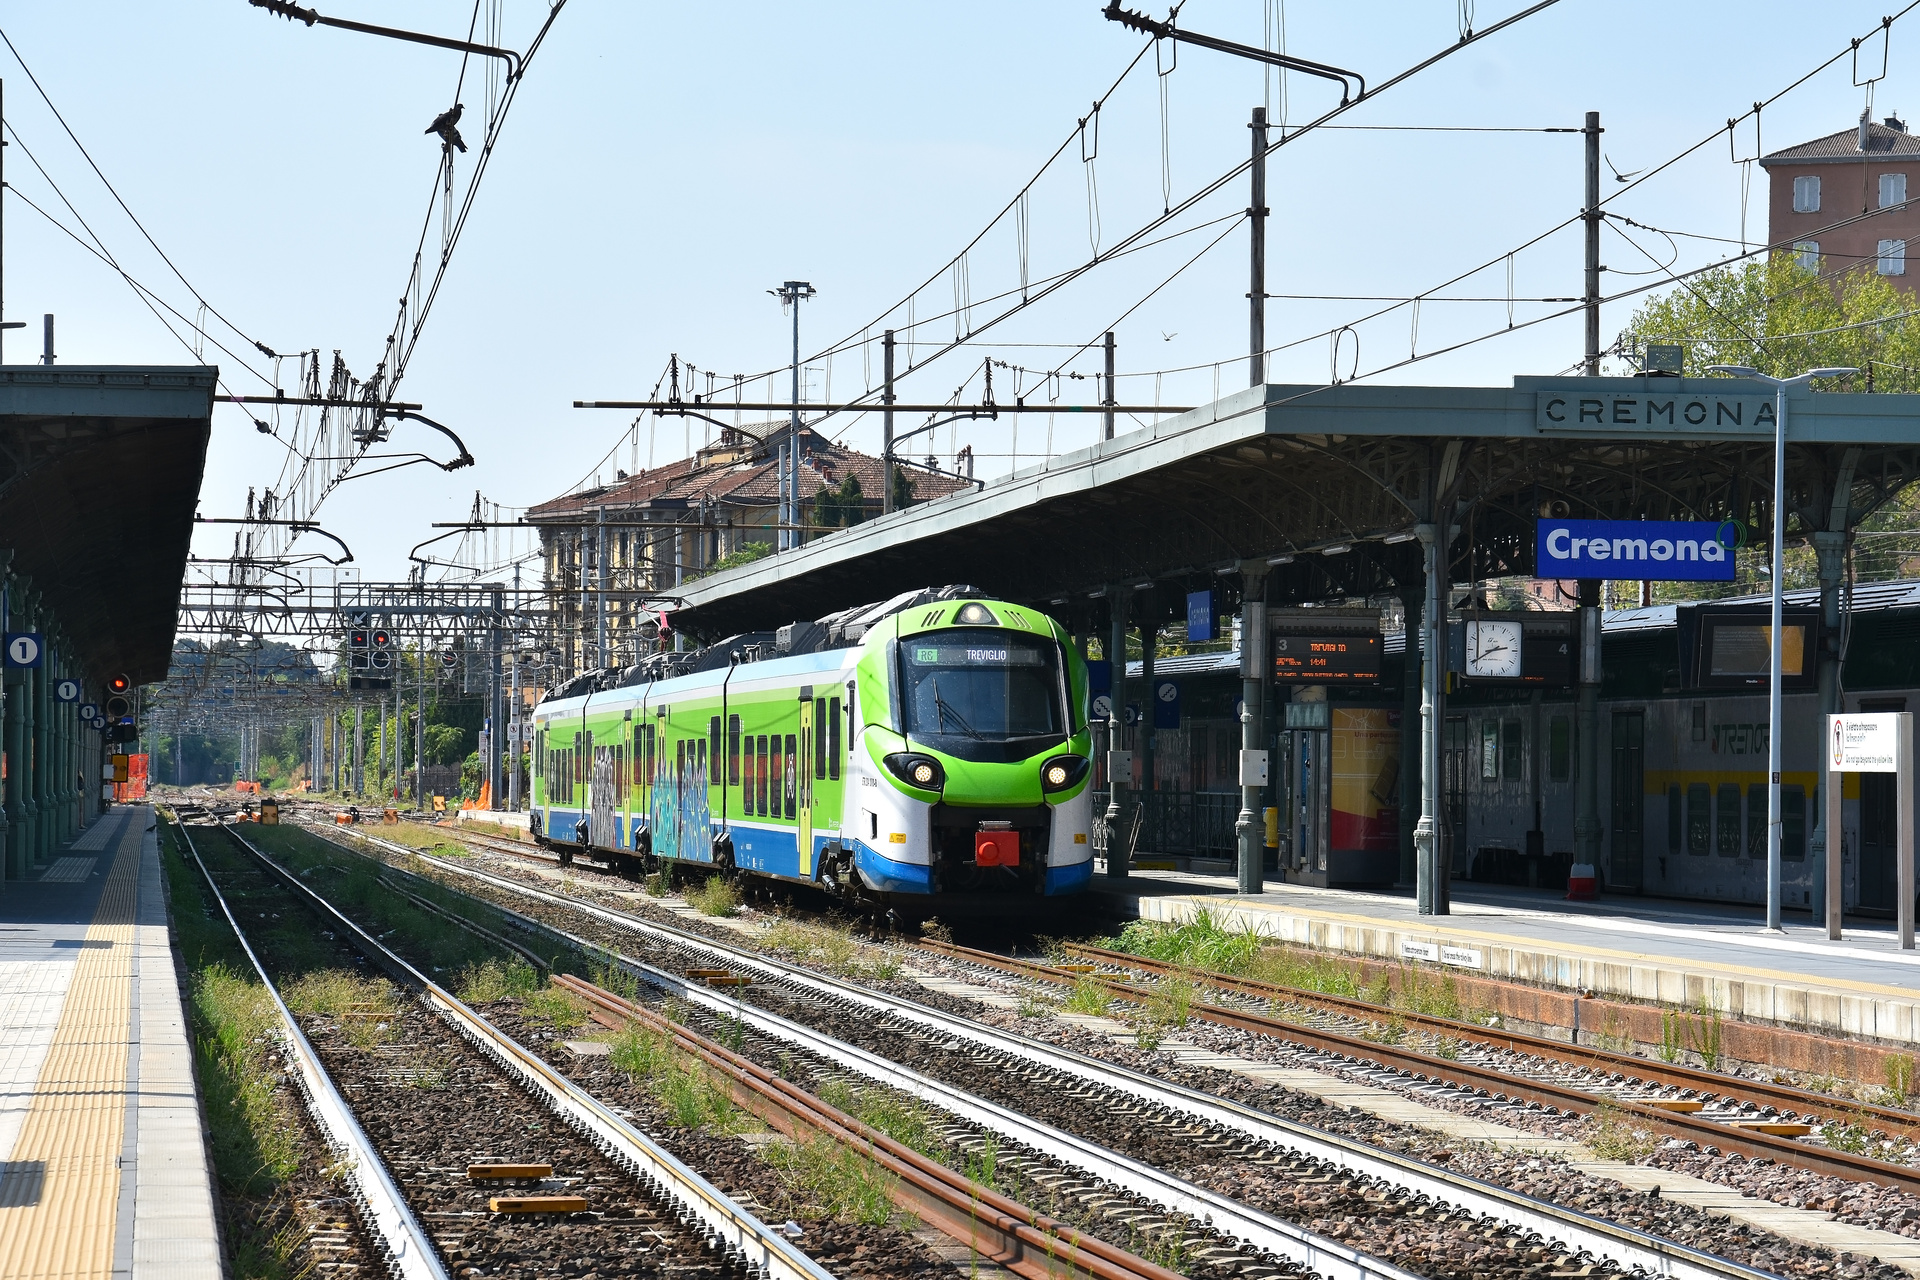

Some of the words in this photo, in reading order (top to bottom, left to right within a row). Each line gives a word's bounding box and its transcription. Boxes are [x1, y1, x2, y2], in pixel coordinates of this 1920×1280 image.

[1545, 398, 1777, 426] CREMONA
[1546, 528, 1725, 562] Cremona
[18, 641, 27, 660] 1
[1278, 639, 1288, 651] 3
[1558, 643, 1568, 655] 4
[966, 649, 1007, 661] TREVIGLIO
[64, 684, 70, 697] 1
[1721, 723, 1770, 755] TRENOR
